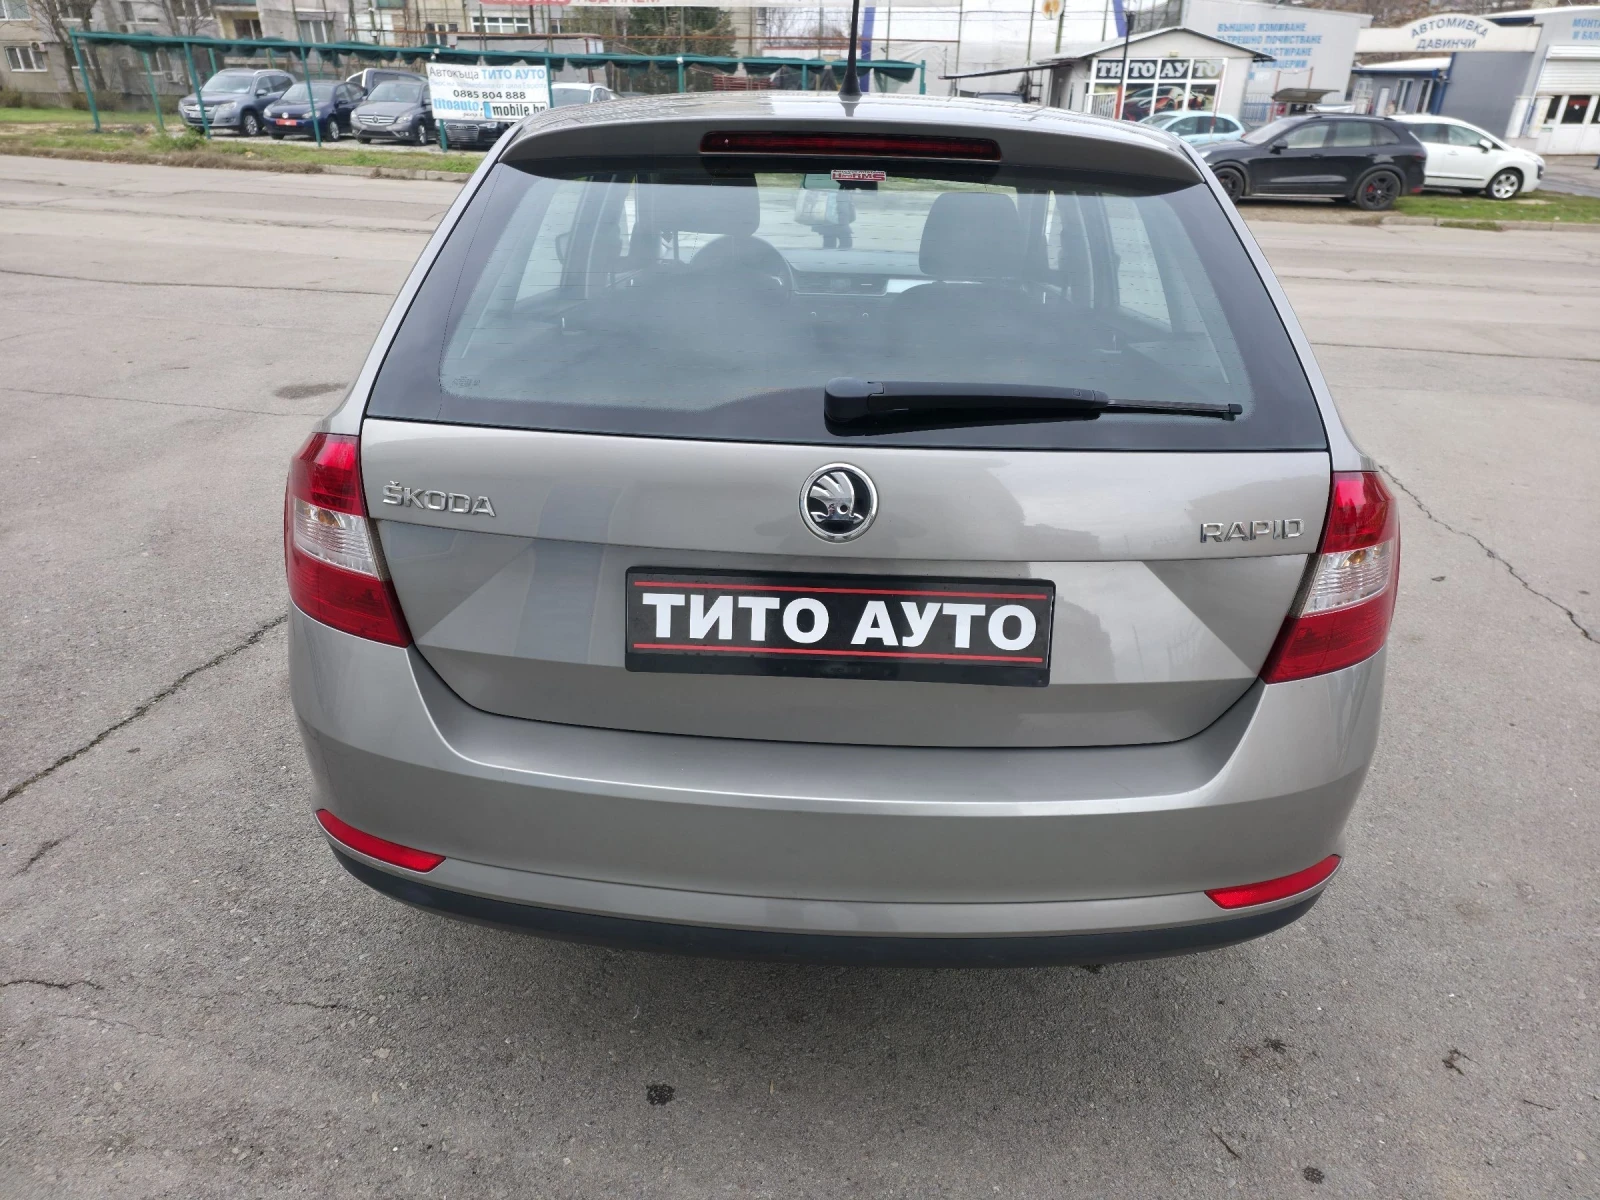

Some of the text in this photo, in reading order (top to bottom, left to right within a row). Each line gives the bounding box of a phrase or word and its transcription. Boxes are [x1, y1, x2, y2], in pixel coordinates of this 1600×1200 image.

[1217, 23, 1306, 32] ВЪНШНО ИЗМИВАНЕ
[1411, 18, 1488, 38] АВТОМИВКА
[1572, 18, 1600, 27] МОНТ
[1264, 35, 1322, 44] ПОЧИСТВАНЕ
[1416, 39, 1476, 50] ДАВИНЧИ
[429, 67, 545, 80] Автокъща ТИТО АУТО
[453, 90, 526, 99] 0885 804 888
[383, 480, 496, 517] ŠKODA
[1200, 519, 1305, 543] RAPID
[642, 592, 1037, 651] ТИТО АУТО
